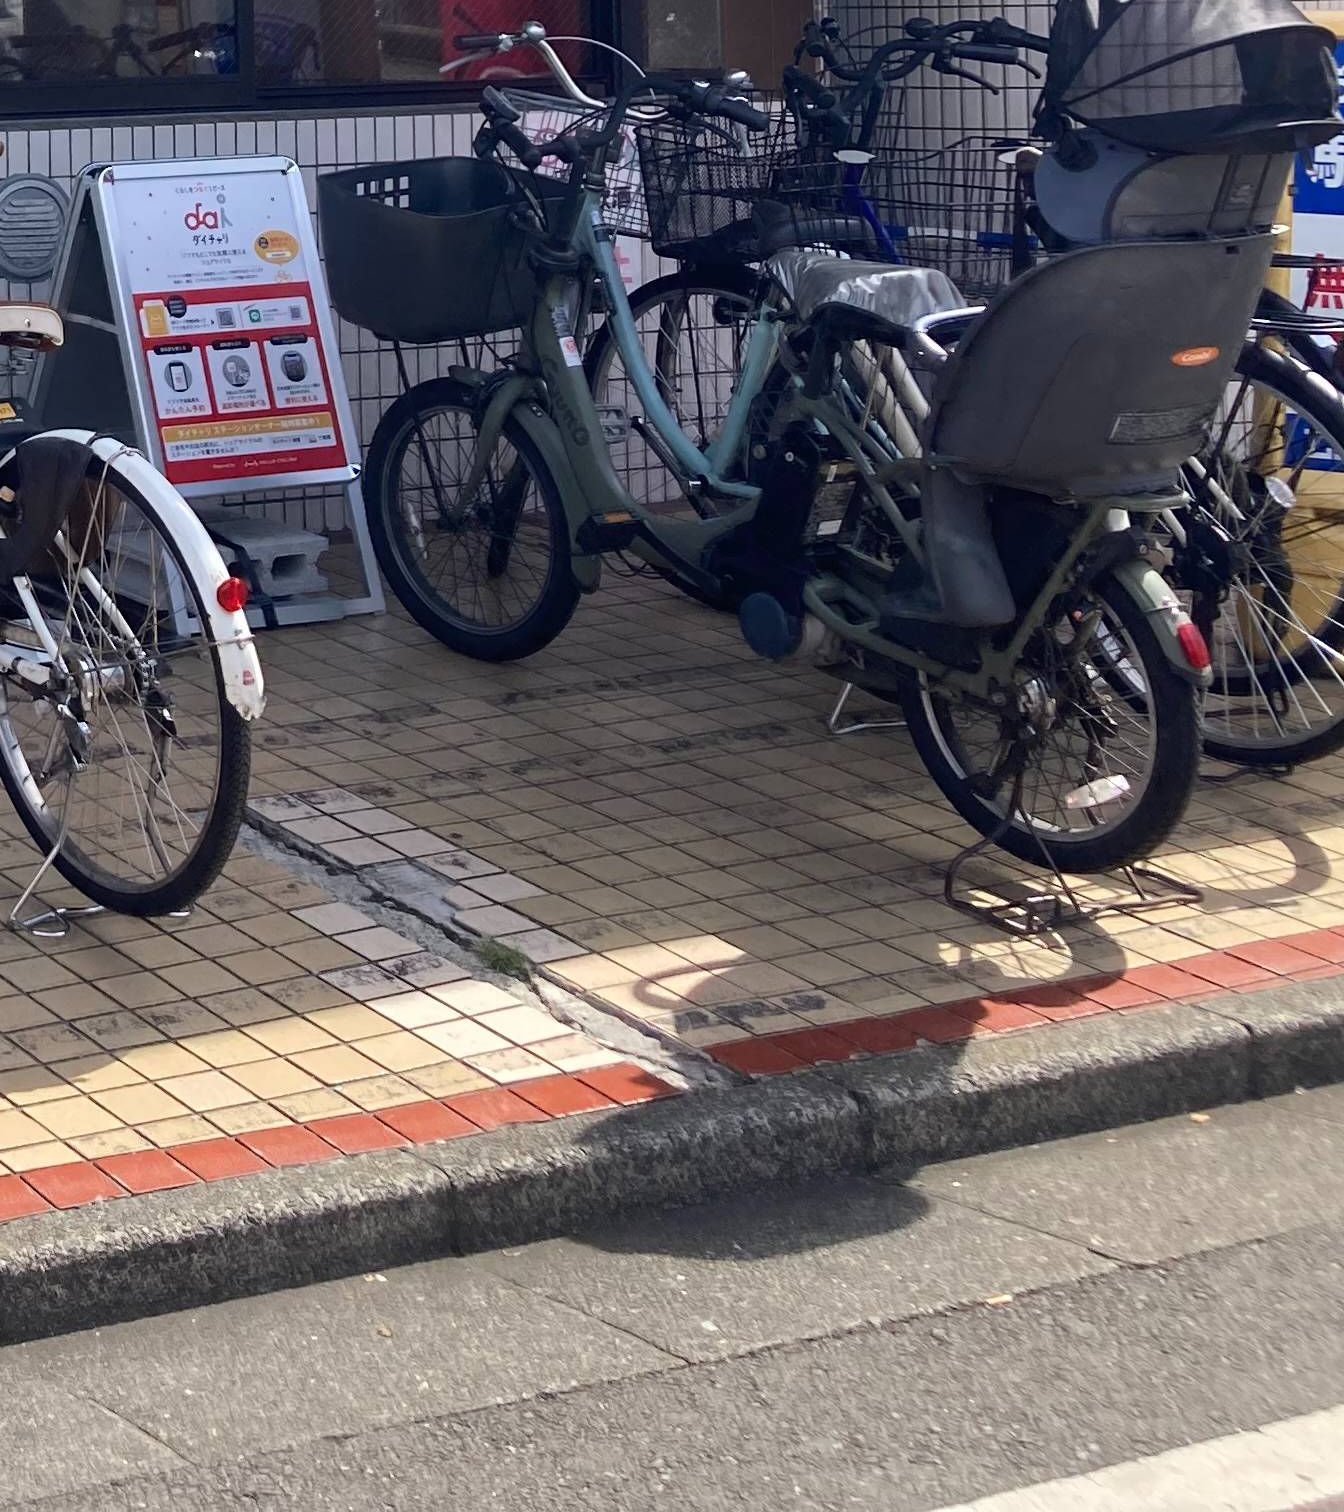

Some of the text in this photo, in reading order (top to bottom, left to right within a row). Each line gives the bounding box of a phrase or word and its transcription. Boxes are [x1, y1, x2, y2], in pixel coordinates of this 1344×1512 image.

[192, 233, 229, 246] ダイチャリ
